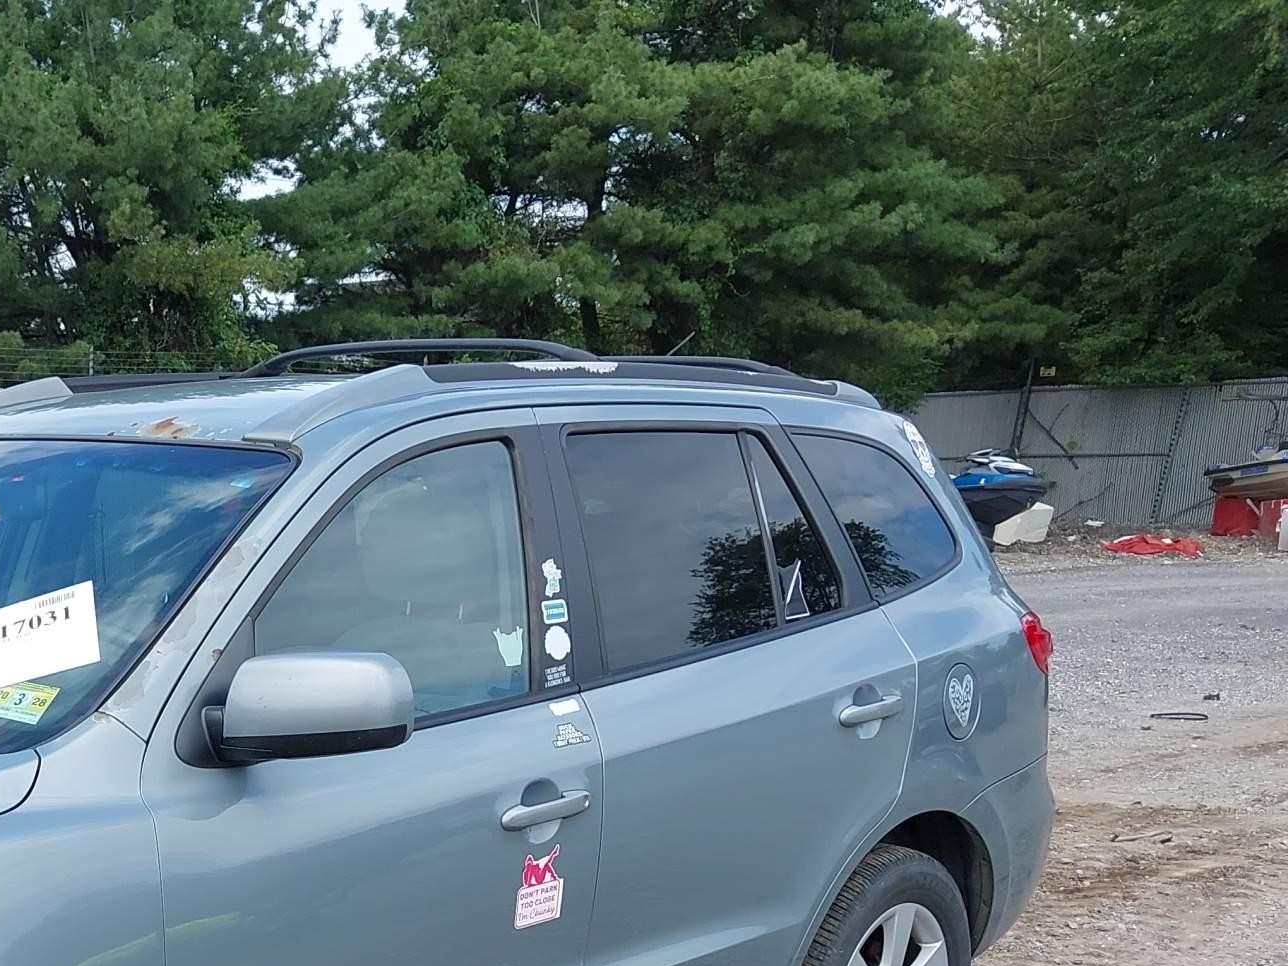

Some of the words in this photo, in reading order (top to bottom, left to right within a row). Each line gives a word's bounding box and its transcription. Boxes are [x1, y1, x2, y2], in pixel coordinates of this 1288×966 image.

[14, 693, 26, 706] 3
[32, 697, 48, 708] 28
[520, 890, 539, 900] DON'T
[541, 885, 558, 894] PARK
[521, 901, 534, 910] TOO
[535, 895, 555, 905] CLOSE
